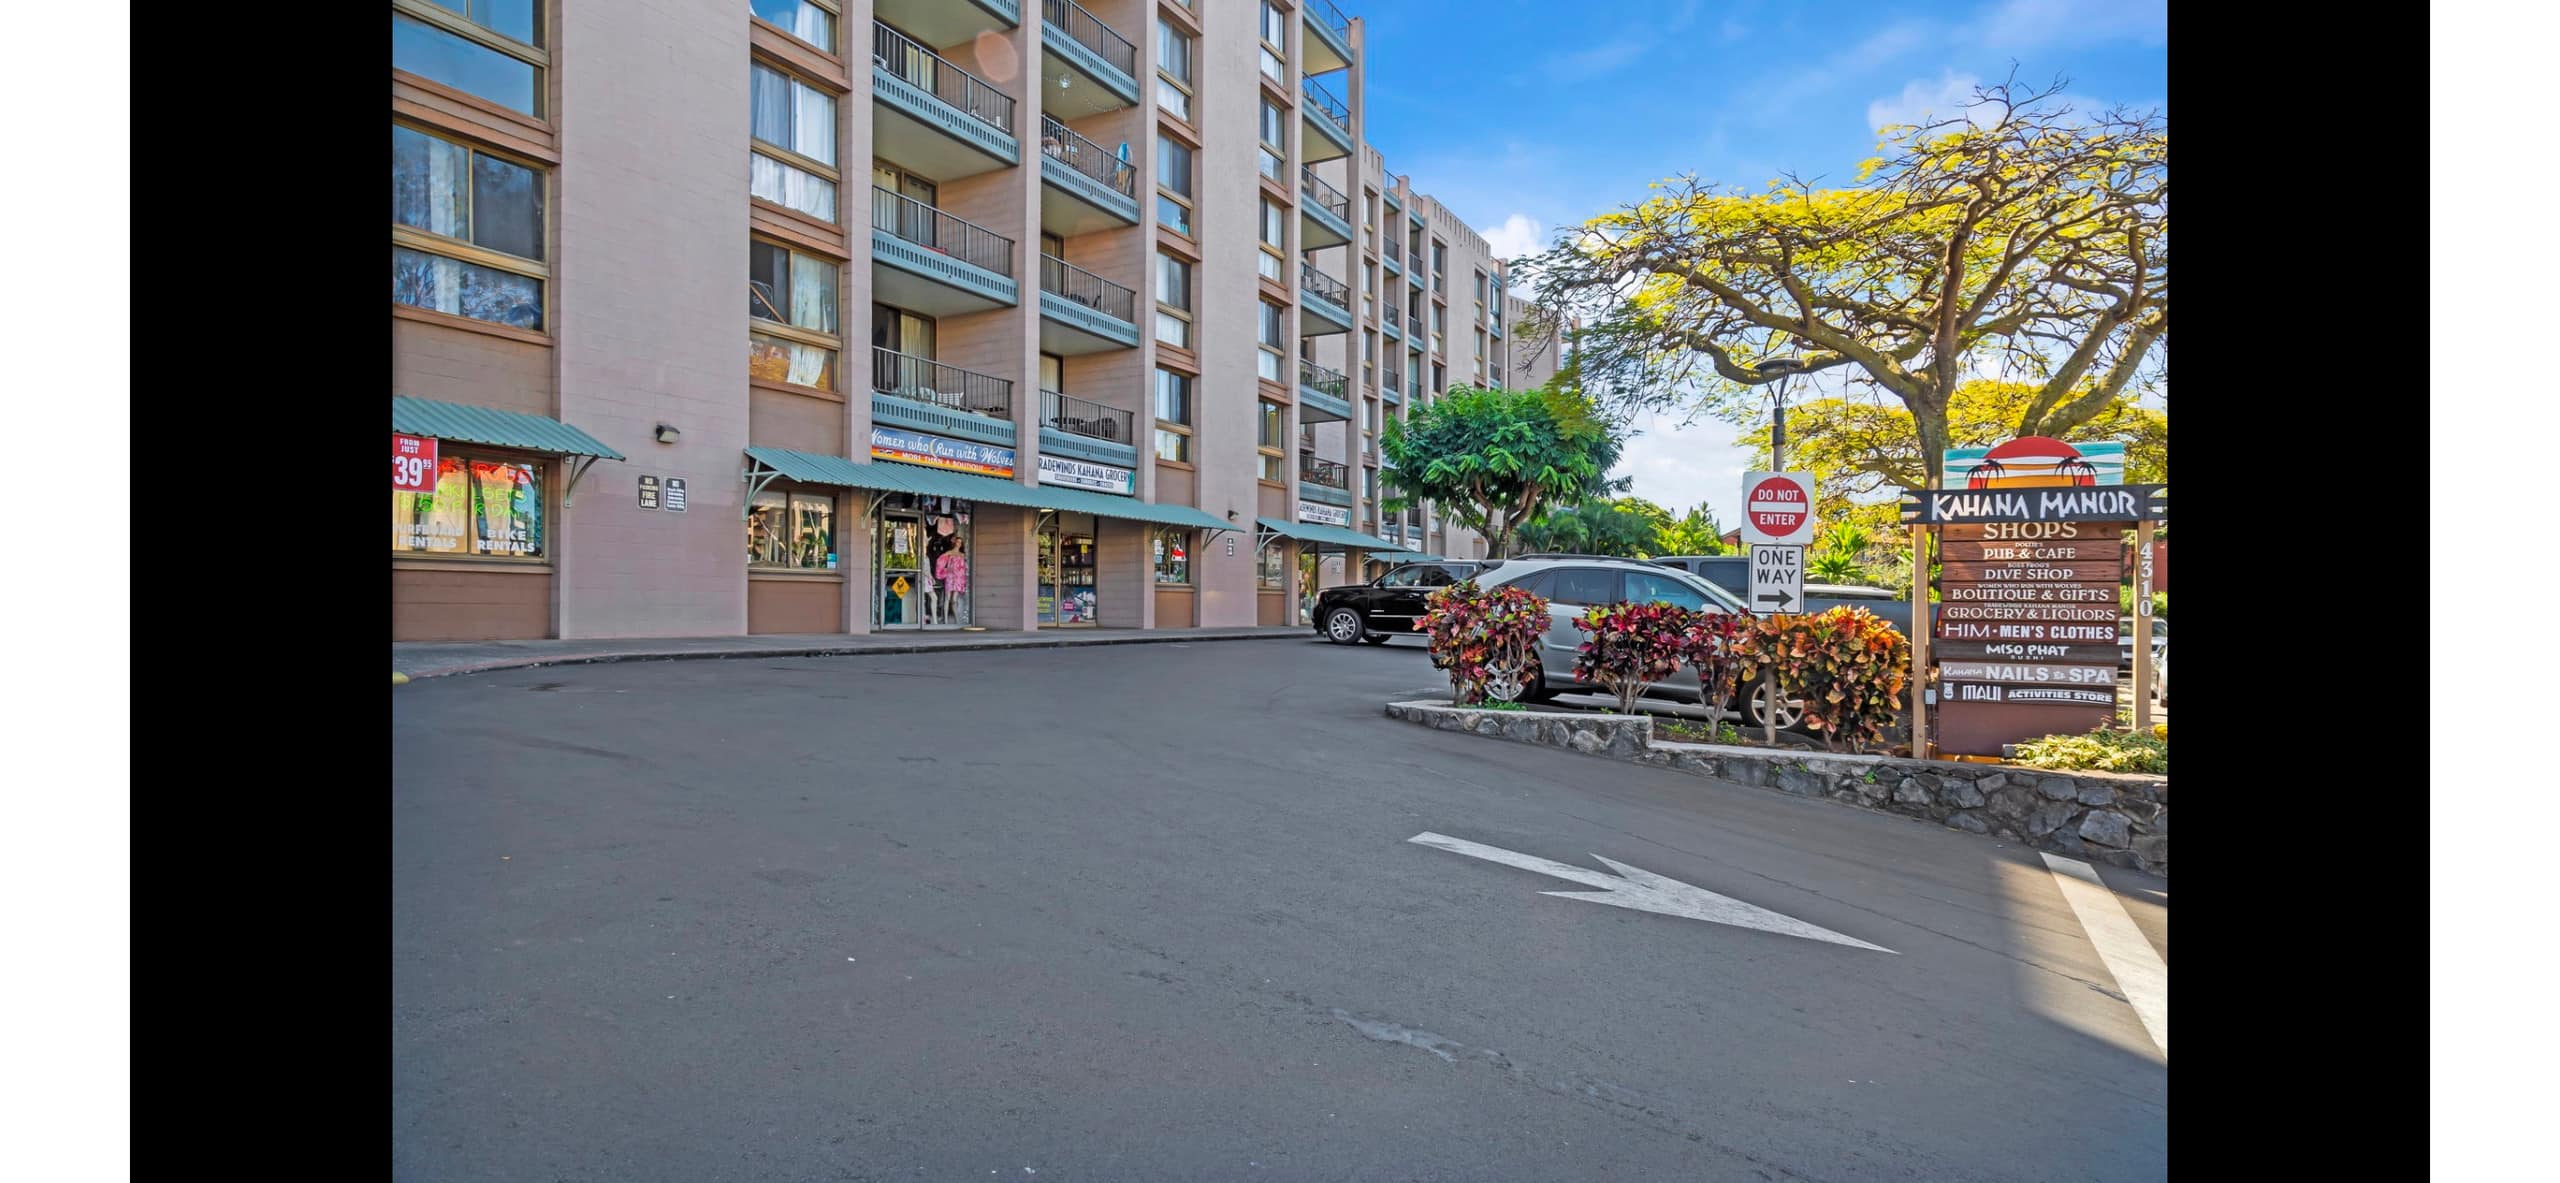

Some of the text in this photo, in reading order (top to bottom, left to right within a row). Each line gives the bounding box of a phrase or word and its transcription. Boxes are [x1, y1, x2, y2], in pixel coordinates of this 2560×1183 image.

[400, 438, 420, 446] FROM
[401, 445, 418, 454] JUST
[908, 436, 929, 452] who
[936, 442, 954, 457] Run
[956, 445, 977, 460] with
[981, 447, 1014, 466] Wolves
[1039, 458, 1076, 474] RADEWINDS
[1077, 463, 1104, 480] KAHANA
[642, 490, 656, 499] FIRE
[1758, 489, 1799, 501] DO NOT
[641, 499, 657, 507] LANE
[1931, 491, 2138, 520] KAHANA MANOR
[1759, 513, 1796, 525] ENTER
[487, 529, 527, 541] BIKE
[1983, 521, 2078, 541] SHOPS
[399, 536, 457, 549] RENTALS
[476, 540, 535, 552] RENTALS
[1759, 550, 1796, 566] ONE
[1983, 547, 2076, 560] PUB & CAFE
[1757, 568, 1796, 585] WAY
[1985, 568, 2073, 580] DIVE SHOP
[2140, 542, 2153, 617] 4310
[1952, 589, 2110, 600] BOUTIQUE & GIFTS
[1947, 607, 2116, 620] GROCERY & LIQUORS
[1945, 623, 2114, 640] HIM MEN'S CLOTHES
[1985, 644, 2070, 656] MISO PHAT
[1986, 665, 2050, 681] NAILS
[2069, 667, 2112, 683] SPA
[1962, 685, 2113, 702] MAUI ACTIVITIES STORE
